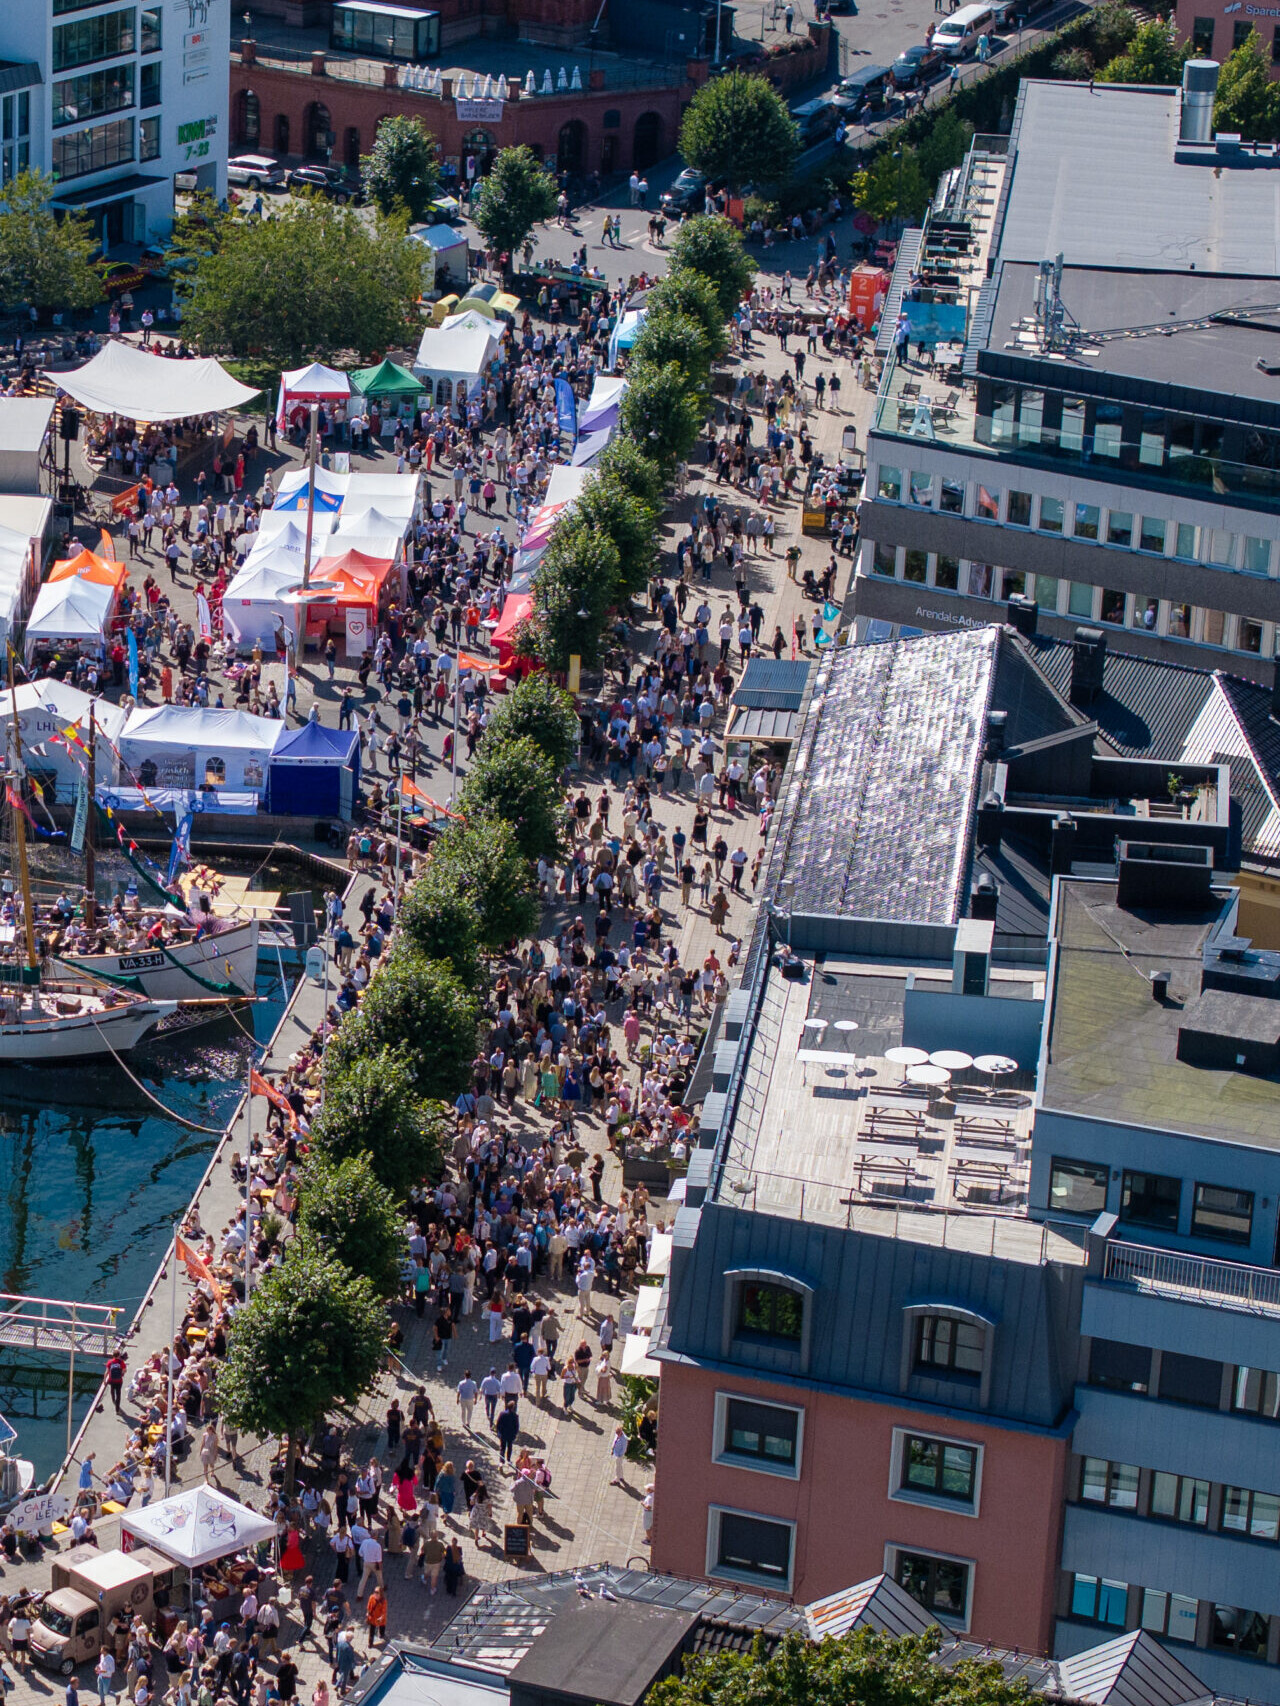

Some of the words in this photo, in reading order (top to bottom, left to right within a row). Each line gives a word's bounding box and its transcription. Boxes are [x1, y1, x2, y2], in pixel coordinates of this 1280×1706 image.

[177, 119, 205, 145] KIWI
[37, 721, 58, 732] LHL
[121, 955, 162, 968] VA-33-H
